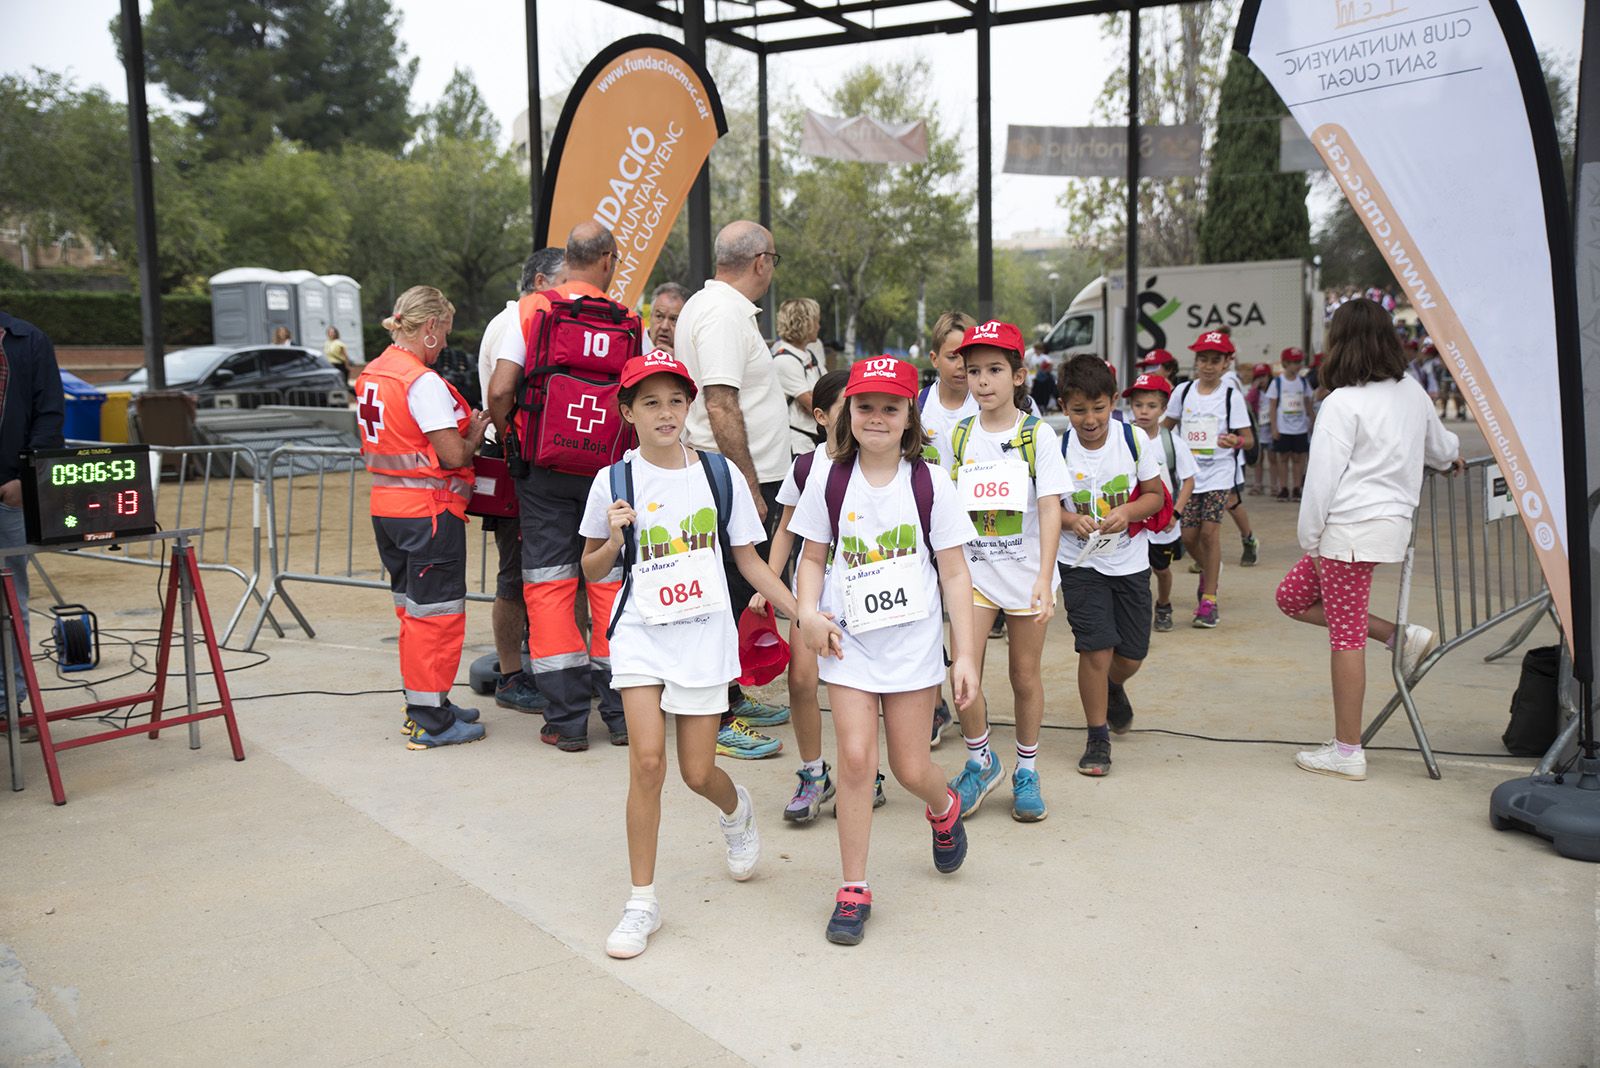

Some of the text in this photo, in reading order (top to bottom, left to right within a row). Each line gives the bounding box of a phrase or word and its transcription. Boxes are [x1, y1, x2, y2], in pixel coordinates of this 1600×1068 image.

[597, 56, 710, 120] www.fundaciocmsc.cat
[609, 188, 670, 303] SANT CUGAT
[1187, 300, 1266, 328] SASA
[583, 331, 610, 358] 10
[865, 358, 899, 371] TOT
[553, 432, 607, 456] Creu Roja
[1188, 431, 1207, 441] 083
[52, 459, 136, 486] 09:06:53
[117, 489, 139, 514] 13
[973, 481, 1010, 498] 086
[659, 579, 704, 607] 084
[864, 587, 908, 614] 084
